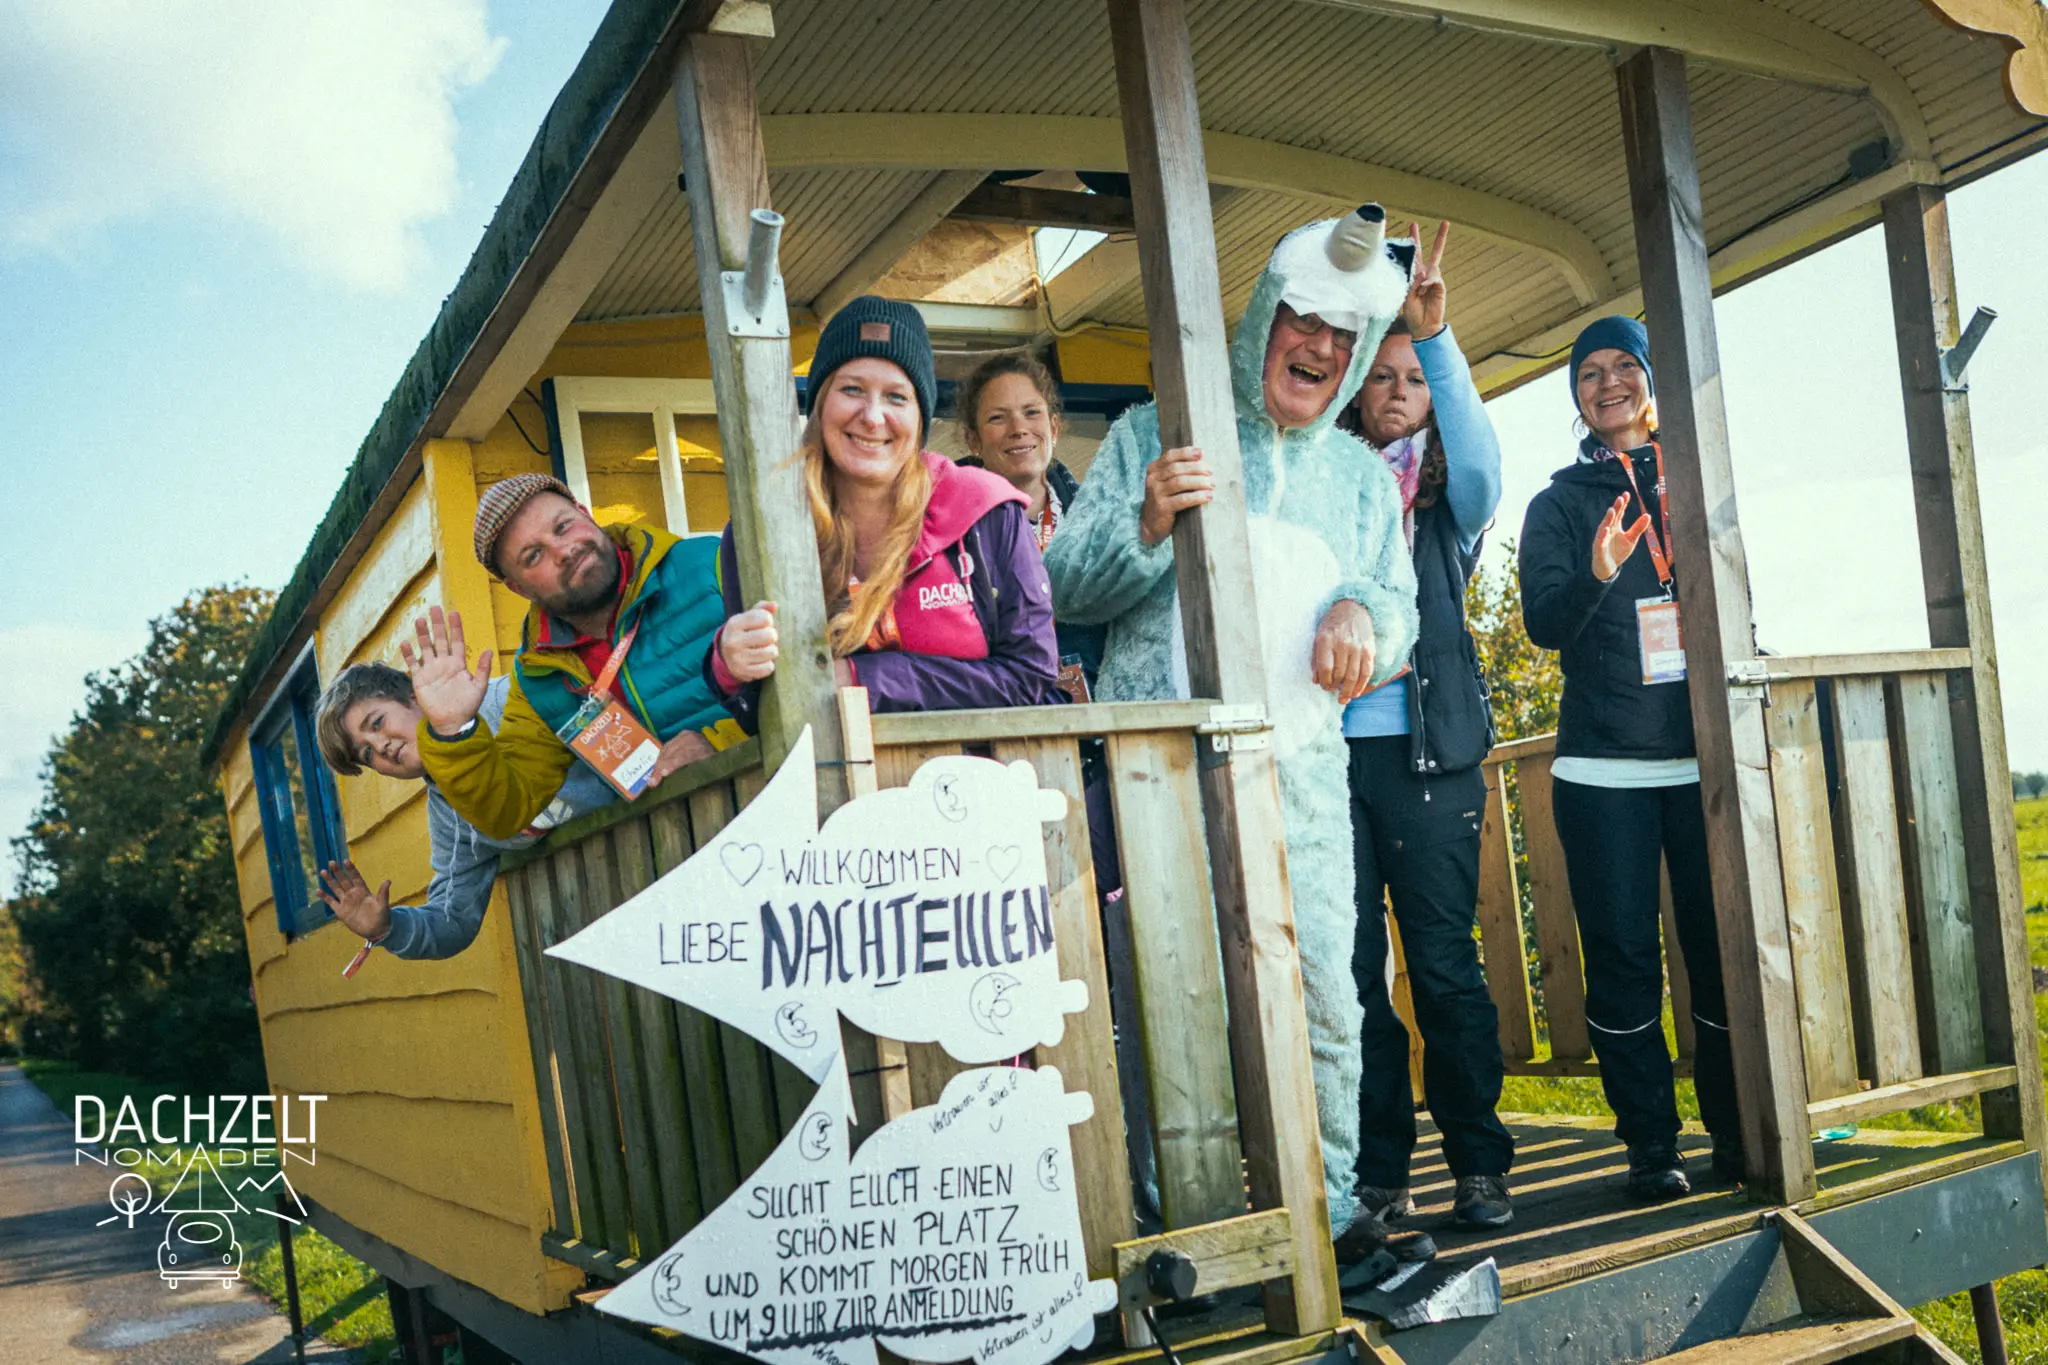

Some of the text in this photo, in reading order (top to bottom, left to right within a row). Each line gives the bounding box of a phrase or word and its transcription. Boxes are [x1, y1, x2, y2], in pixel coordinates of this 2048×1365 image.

[580, 711, 613, 744] DACHZELT
[660, 885, 1054, 990] LIEBE NACHTEULEN
[929, 1094, 975, 1134] Vertrauen
[748, 1164, 1012, 1219] SUCHT EUCH EINEN
[777, 1205, 1019, 1259] SCHÖNEN PLATZ
[705, 1233, 1069, 1298] UND KOMMT MORGEN FRÜH
[710, 1285, 1014, 1341] UM 9 UHR ZUR ANMELDUNG
[979, 1327, 1028, 1361] Vertrauen
